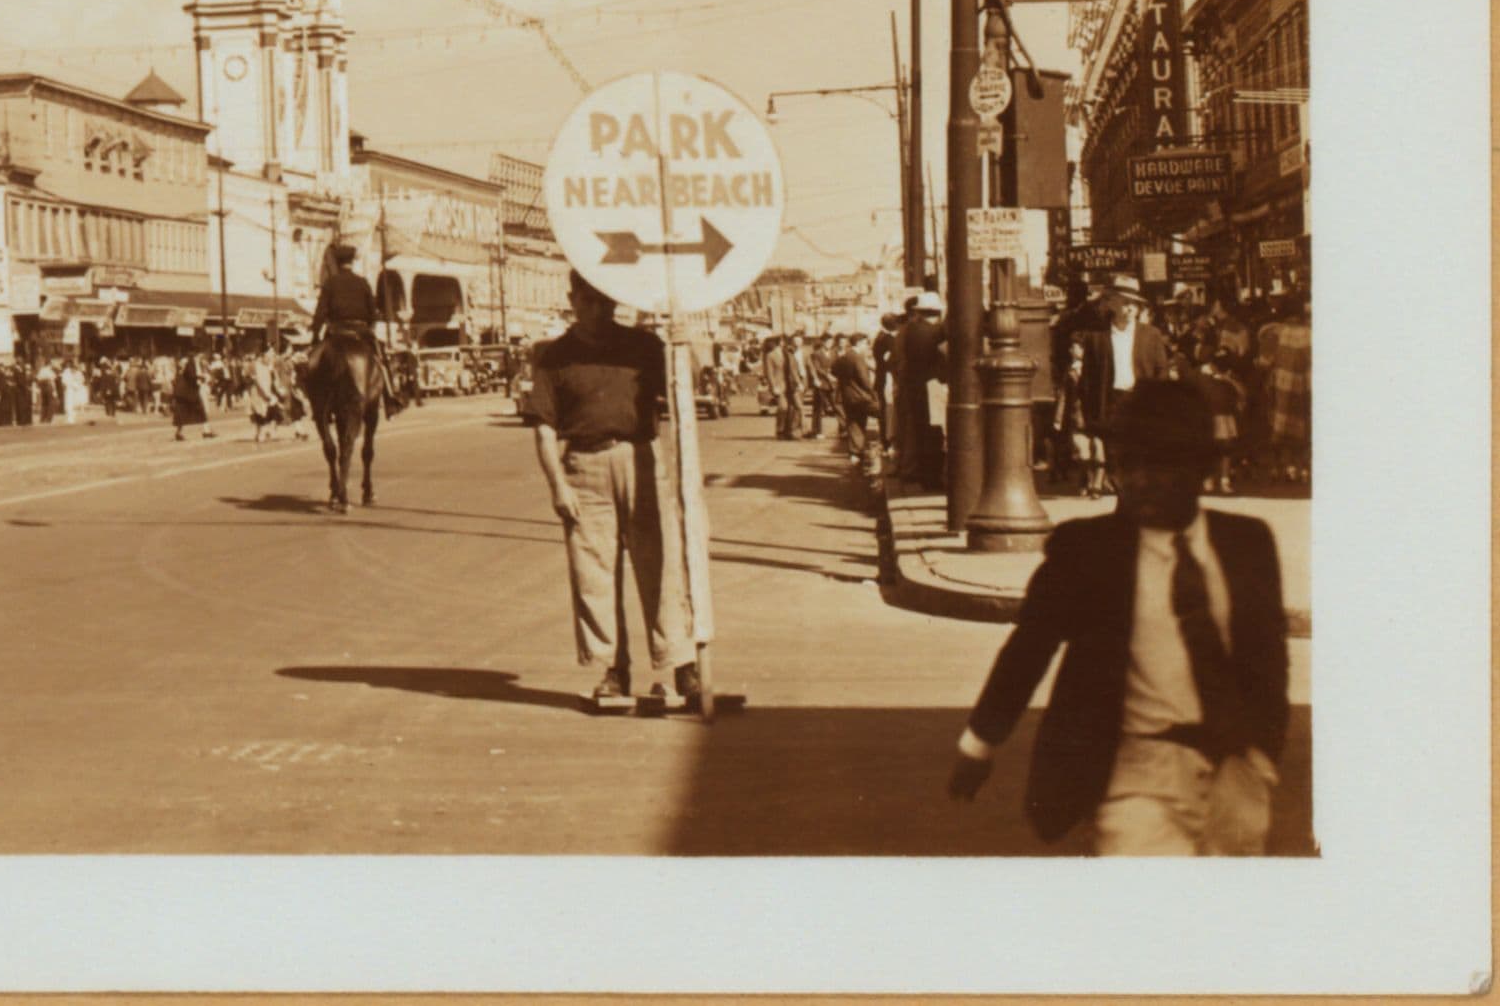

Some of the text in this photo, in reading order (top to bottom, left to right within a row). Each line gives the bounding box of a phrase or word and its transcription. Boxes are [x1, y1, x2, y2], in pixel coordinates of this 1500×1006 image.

[589, 109, 743, 160] PARK
[1135, 158, 1223, 178] HARDWARE
[563, 172, 775, 209] NEAR BEACH
